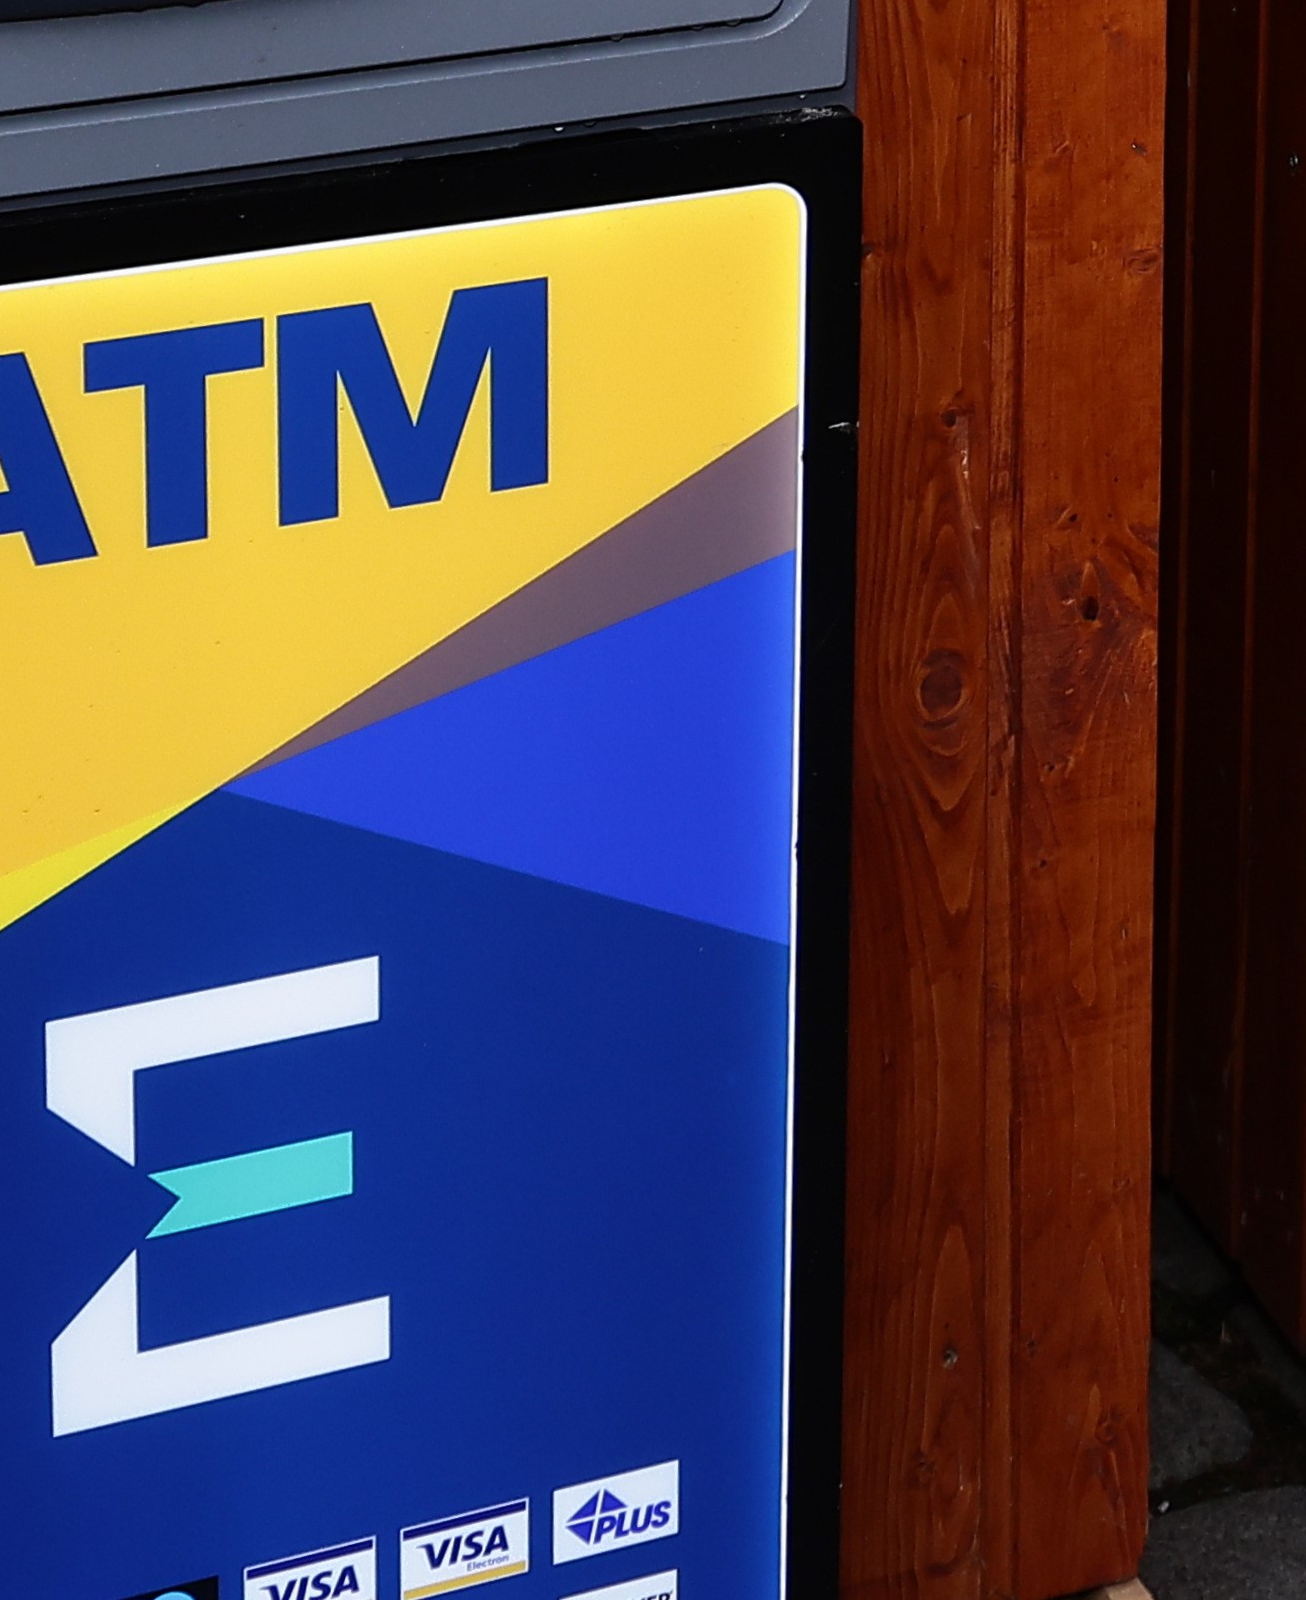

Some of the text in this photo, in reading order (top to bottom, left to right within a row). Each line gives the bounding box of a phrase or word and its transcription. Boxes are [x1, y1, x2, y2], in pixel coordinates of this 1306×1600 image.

[592, 1500, 673, 1546] PLUS
[415, 1525, 510, 1571] VISA
[465, 1553, 510, 1572] Electron
[260, 1564, 360, 1600] VISA
